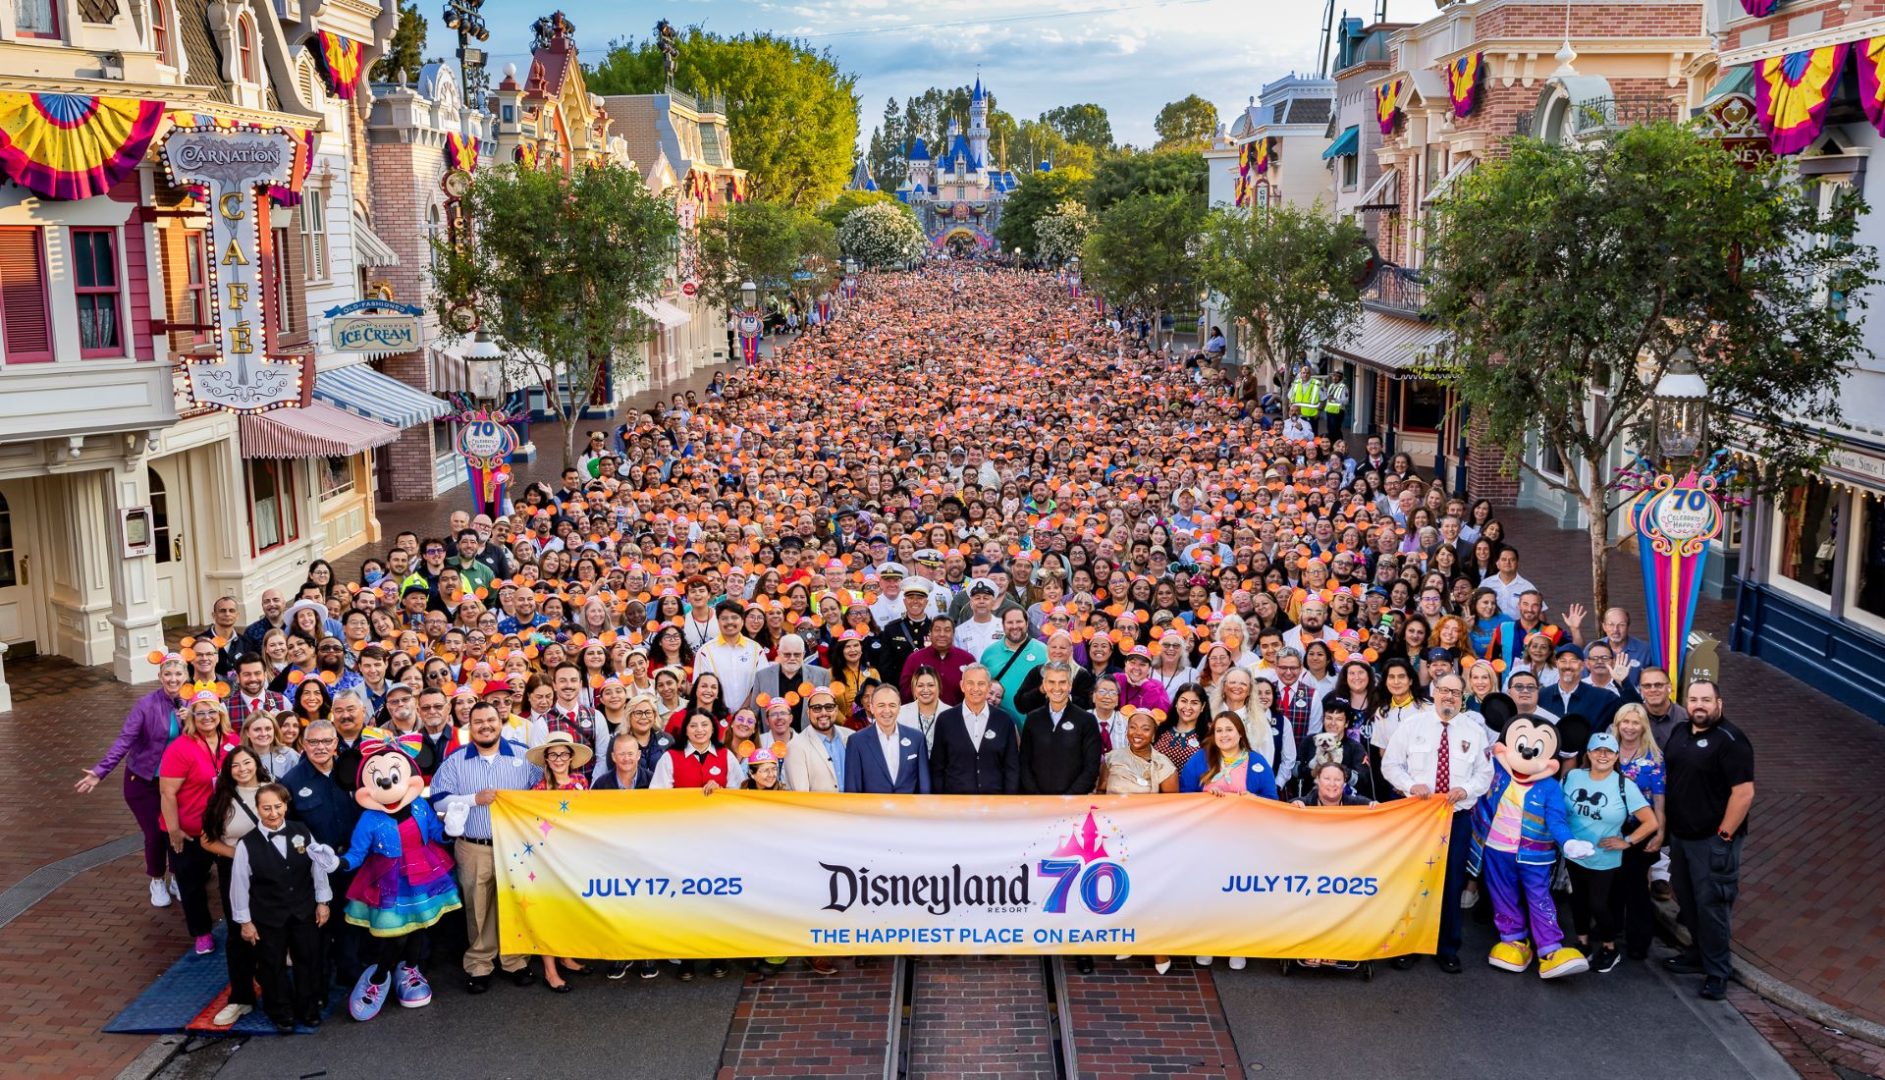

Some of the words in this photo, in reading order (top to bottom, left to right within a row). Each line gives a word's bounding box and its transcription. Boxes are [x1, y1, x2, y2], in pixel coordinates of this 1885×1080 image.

[176, 144, 281, 170] CARNATION
[219, 192, 254, 354] CAFÉ
[343, 301, 406, 313] OLD-FASHIONED
[340, 329, 361, 346] ICE
[364, 328, 412, 346] CREAM
[471, 421, 495, 436] 70
[1859, 456, 1878, 474] Since
[1672, 489, 1707, 511] 70
[1693, 668, 1711, 676] U.S.
[1577, 803, 1590, 816] 70
[582, 878, 641, 897] JULY
[645, 878, 676, 898] 17,
[681, 877, 743, 896] 2025
[818, 860, 1032, 915] Disneyland
[1037, 859, 1130, 915] 70
[1222, 875, 1280, 892] JULY
[1284, 876, 1311, 896] 17,
[1317, 876, 1379, 896] 2025
[810, 929, 850, 944] THE
[856, 928, 955, 943] HAPPIEST
[960, 929, 1024, 943] PLACE
[1034, 929, 1059, 943] ON
[1070, 929, 1135, 943] EARTH
